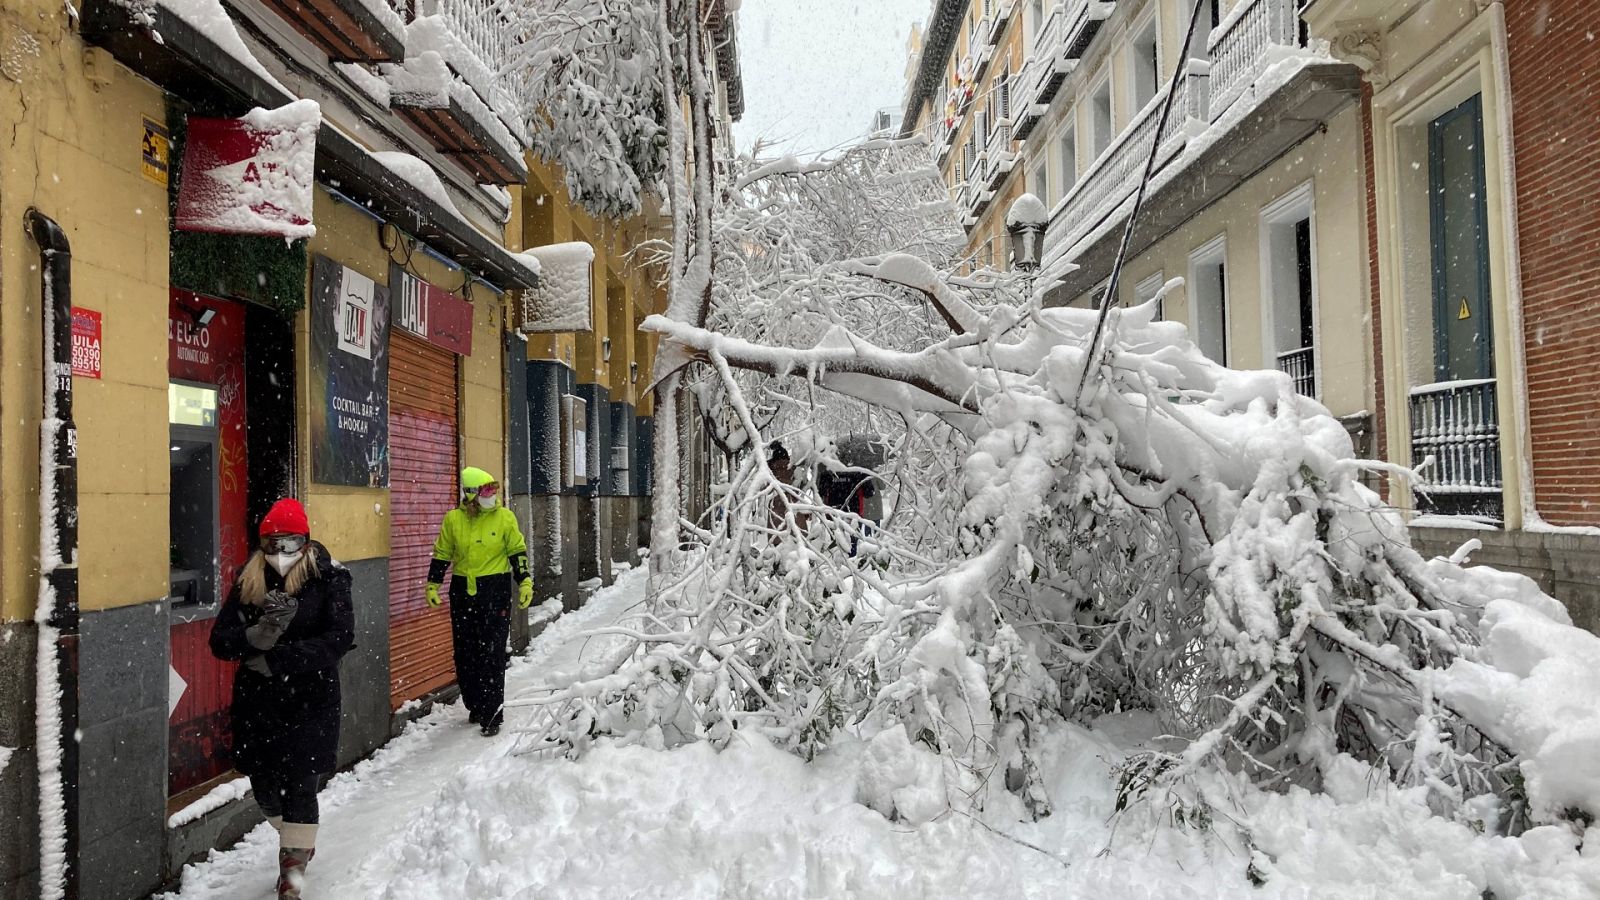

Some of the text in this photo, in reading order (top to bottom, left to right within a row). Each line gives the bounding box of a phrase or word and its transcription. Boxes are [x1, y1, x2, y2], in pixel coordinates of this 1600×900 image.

[71, 334, 100, 350] UILA
[177, 320, 210, 348] EURO
[332, 396, 373, 418] COCKTAIL BAR
[338, 415, 369, 434] & HOOKAH
